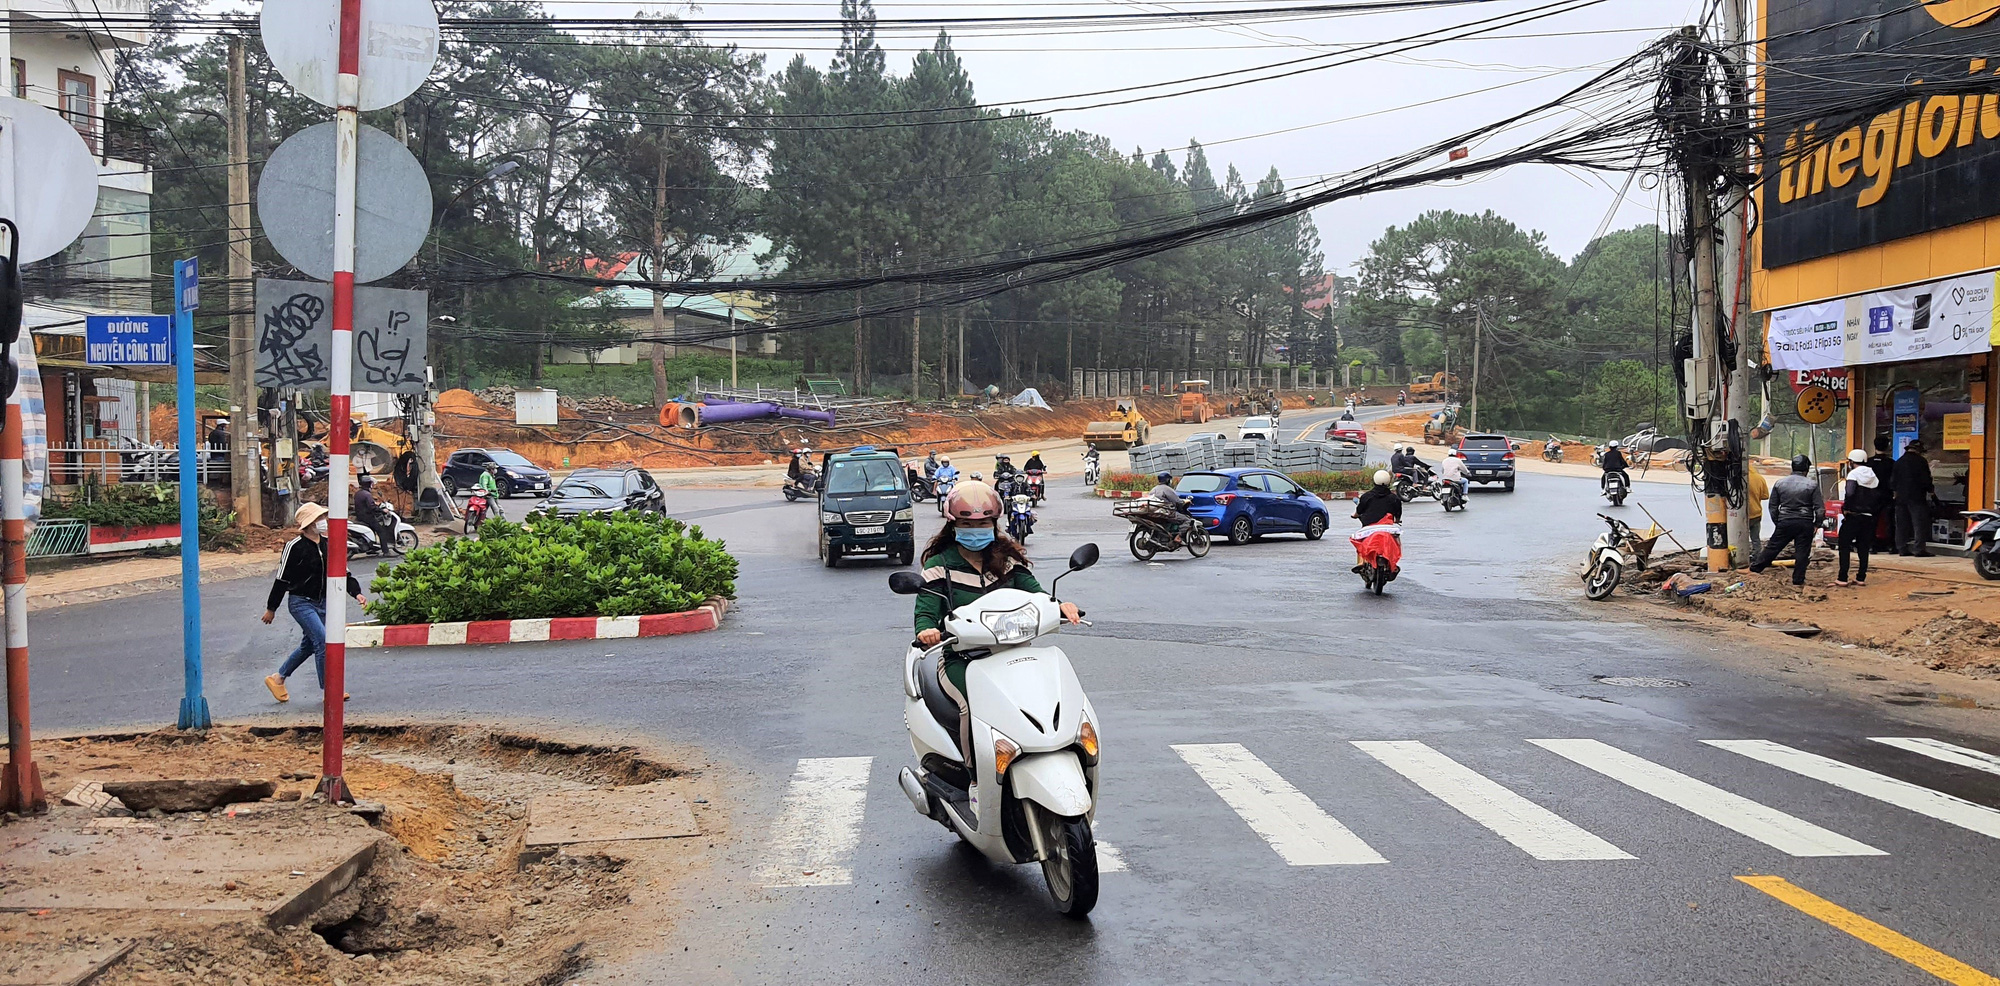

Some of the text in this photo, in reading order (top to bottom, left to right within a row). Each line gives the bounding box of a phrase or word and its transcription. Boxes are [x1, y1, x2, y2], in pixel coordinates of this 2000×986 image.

[107, 316, 149, 334] ĐƯỜNG
[90, 336, 167, 362] NGUYỄN CÔNG TRỨ
